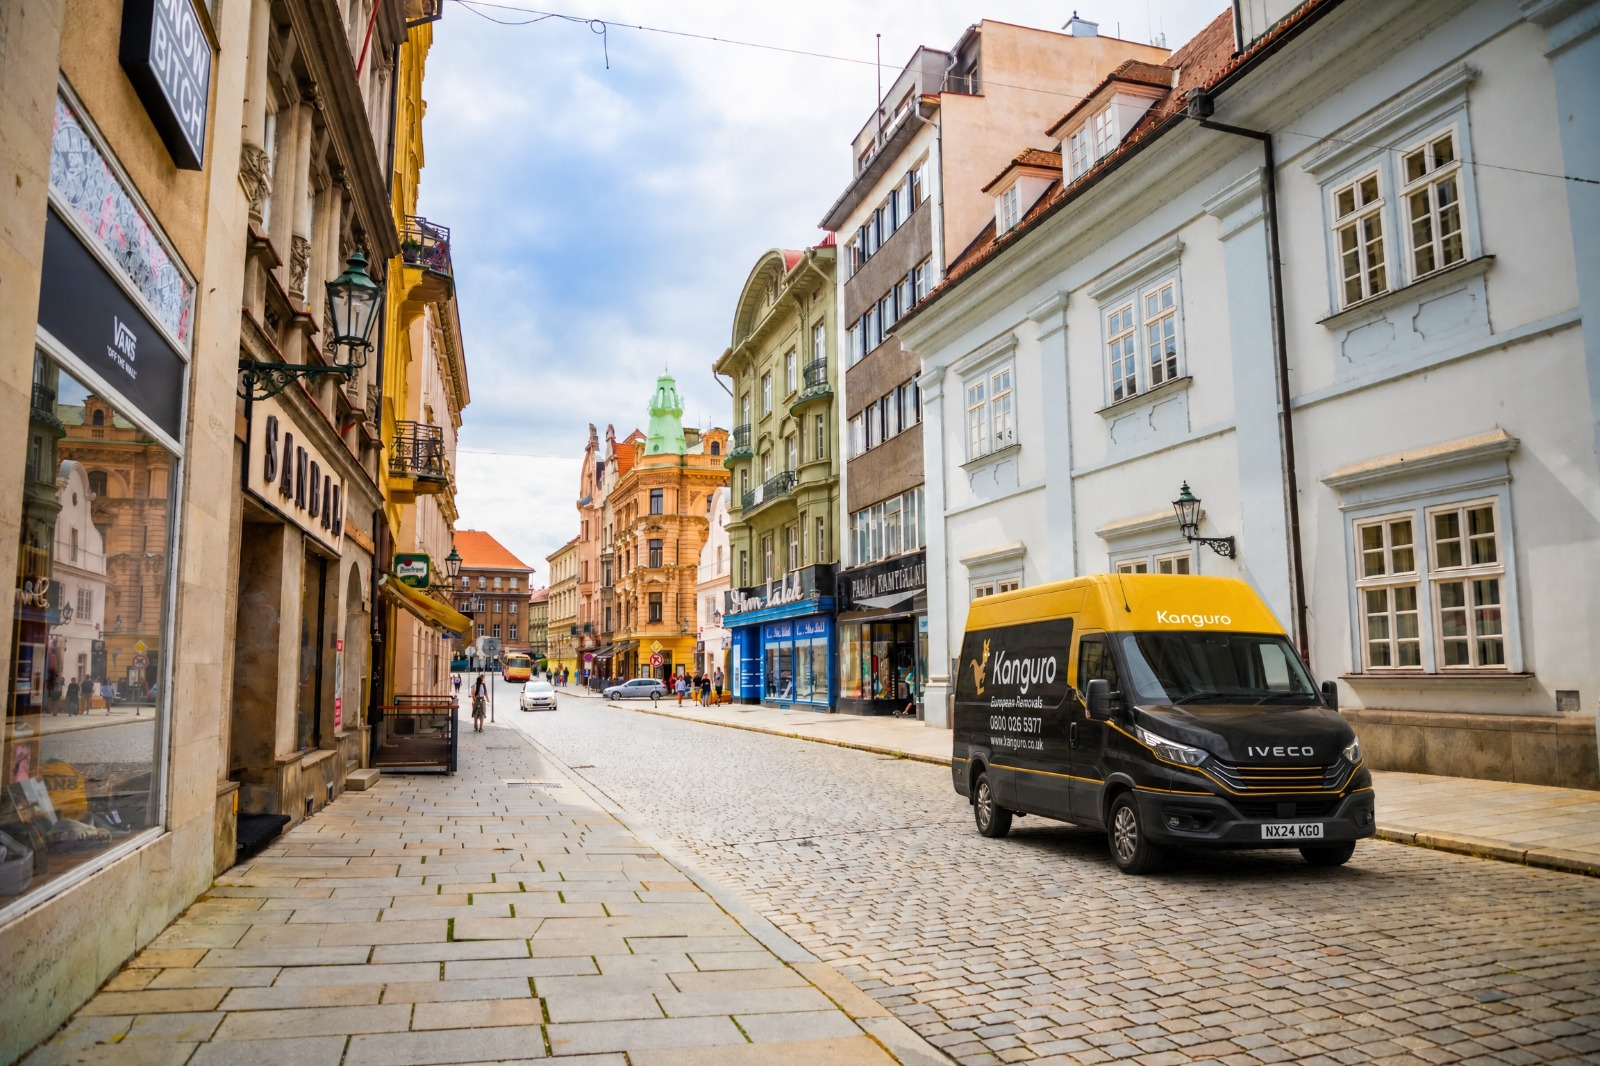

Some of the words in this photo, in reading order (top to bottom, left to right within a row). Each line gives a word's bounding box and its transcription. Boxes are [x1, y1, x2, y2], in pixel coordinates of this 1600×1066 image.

[154, 15, 203, 147] BITCH
[114, 315, 137, 362] VANS
[1156, 610, 1231, 627] Kanguro
[992, 650, 1057, 695] Kanguro
[990, 696, 1015, 711] European
[1016, 696, 1043, 709] Removals
[1007, 716, 1021, 732] 026
[990, 735, 1044, 750] www.kanguro.co.uk
[1247, 746, 1314, 757] IVECO
[1265, 825, 1295, 837] NX24
[1298, 824, 1320, 837] KGO
